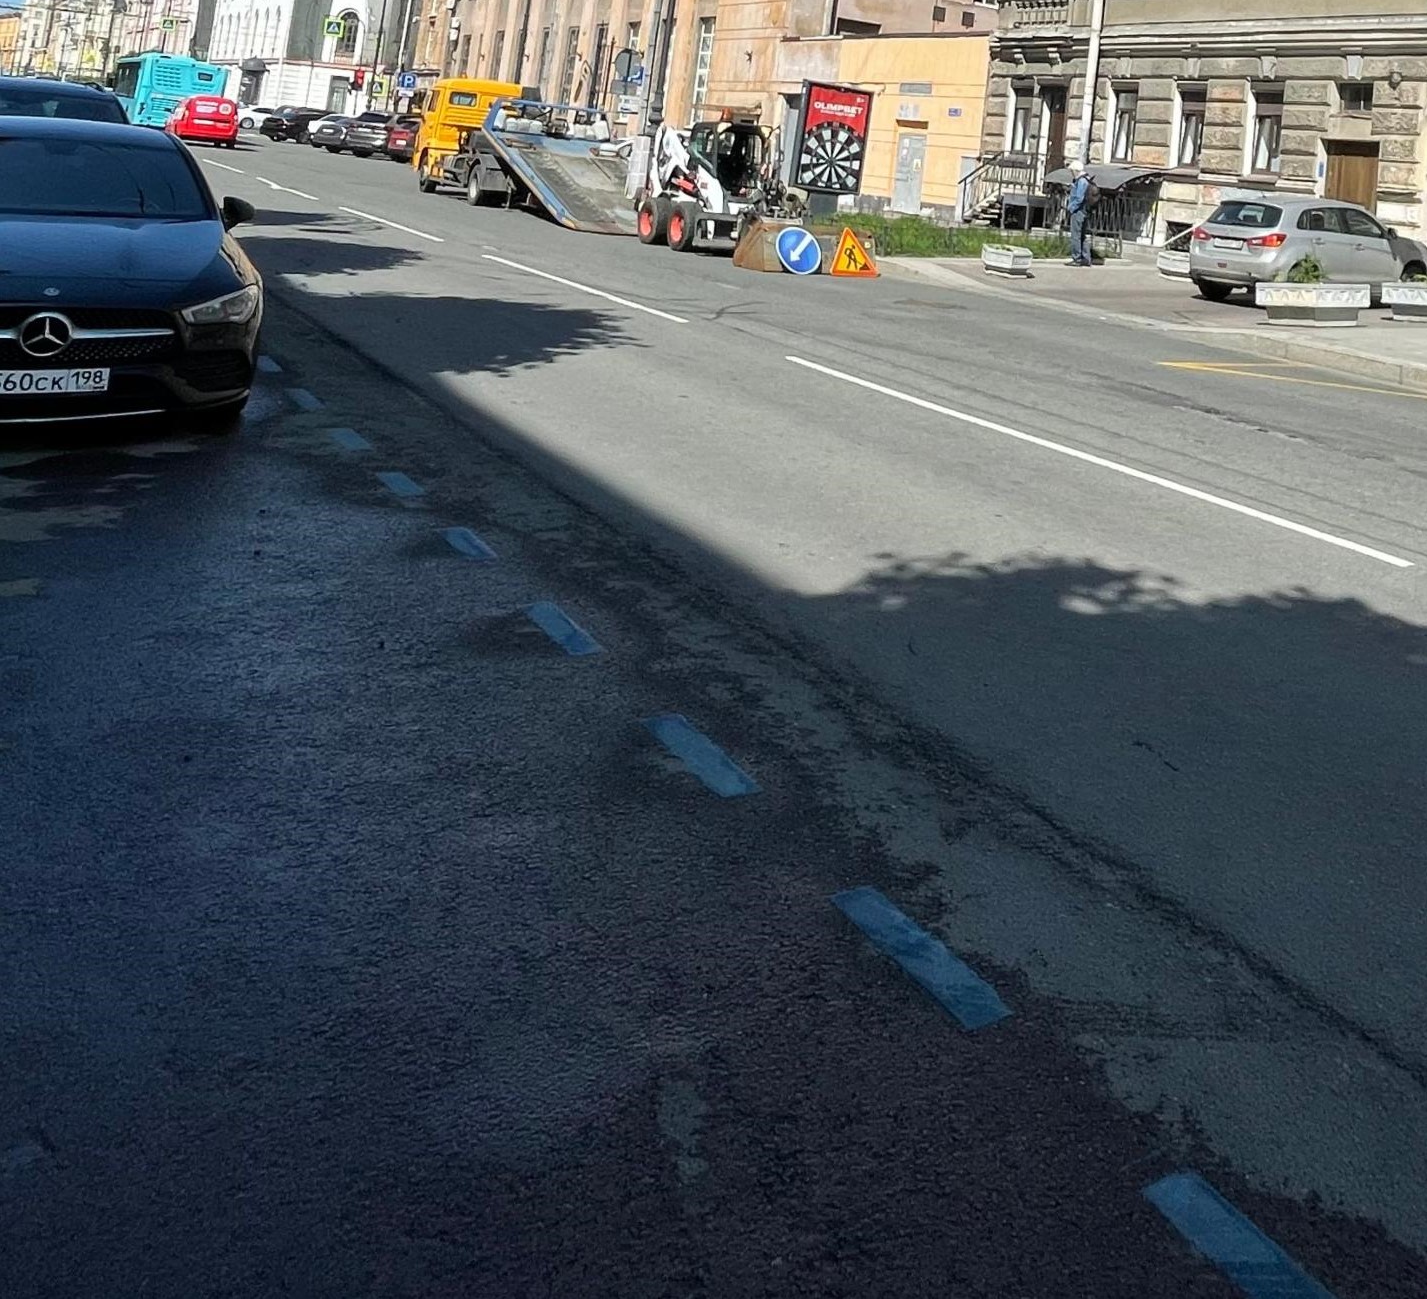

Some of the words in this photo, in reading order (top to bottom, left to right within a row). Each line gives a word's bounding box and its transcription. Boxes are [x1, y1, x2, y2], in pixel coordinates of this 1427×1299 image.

[404, 75, 414, 87] P
[814, 101, 863, 115] OLIMPBET
[71, 369, 104, 385] 198
